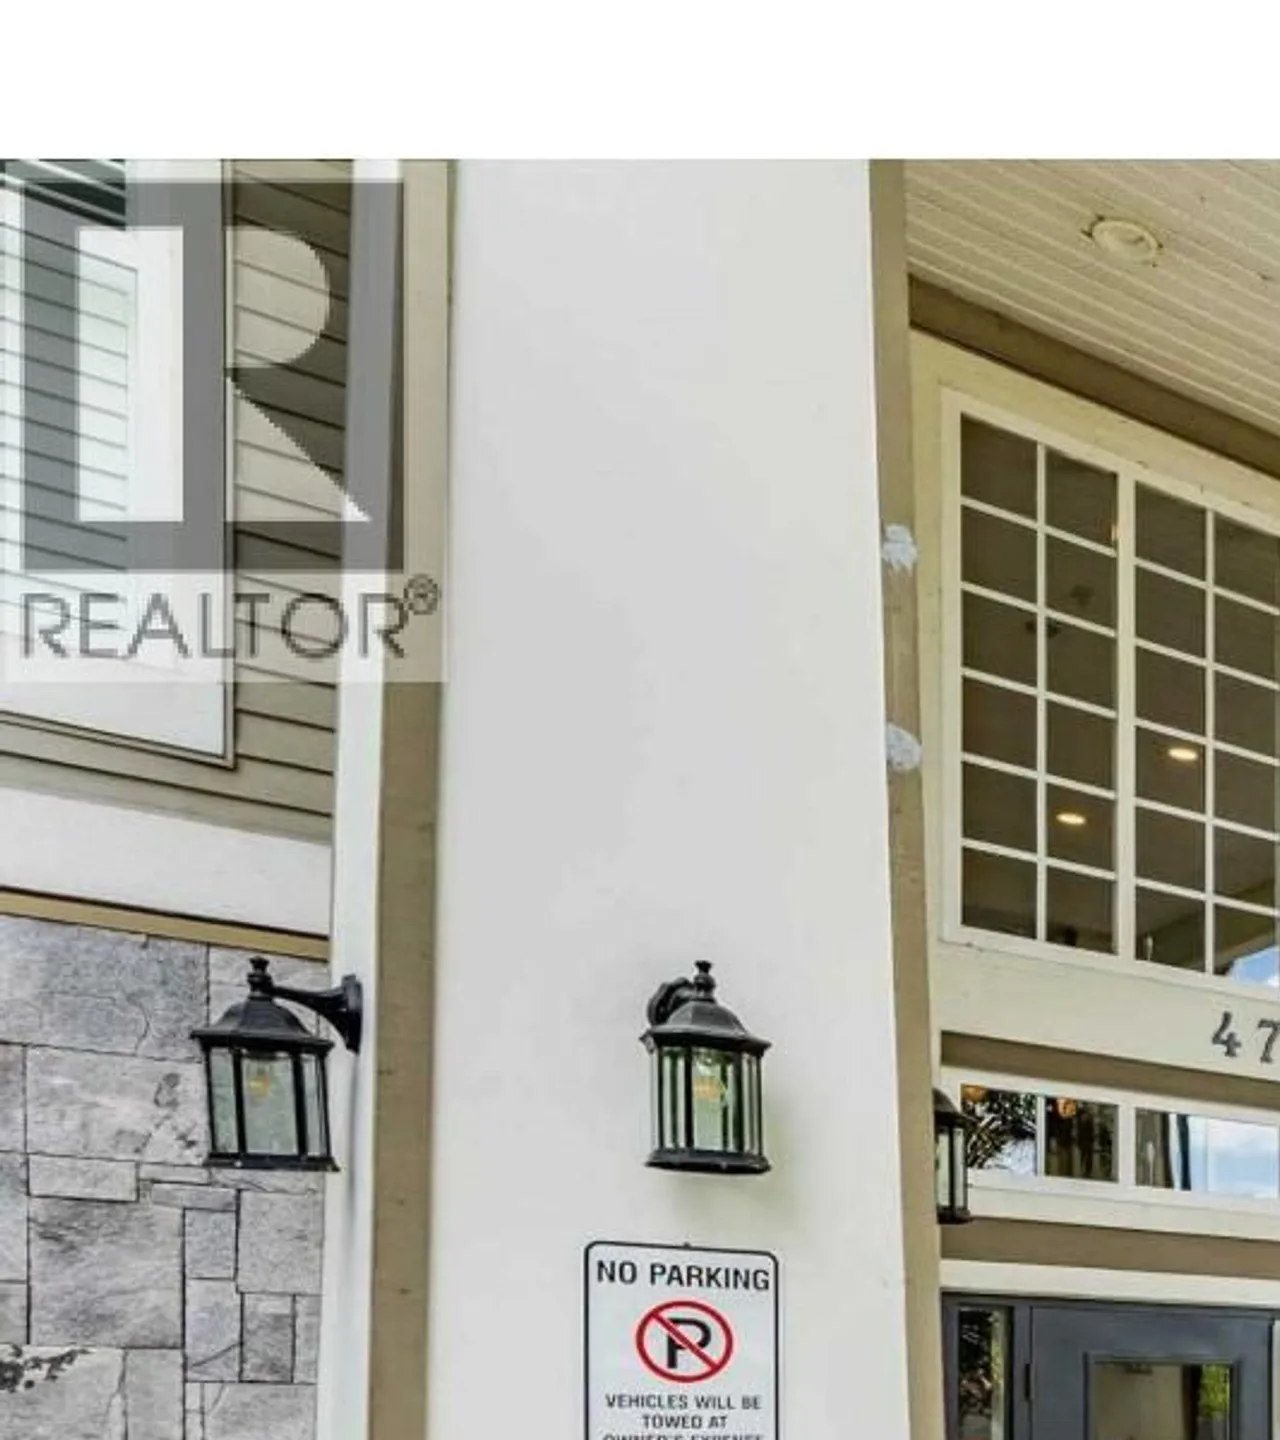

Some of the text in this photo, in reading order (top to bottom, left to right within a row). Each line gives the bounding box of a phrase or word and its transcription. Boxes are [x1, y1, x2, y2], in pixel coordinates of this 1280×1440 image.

[596, 1259, 771, 1291] NO PARKING
[604, 1394, 762, 1410] VEHICLES WILL BE
[641, 1415, 728, 1430] TOWED AT
